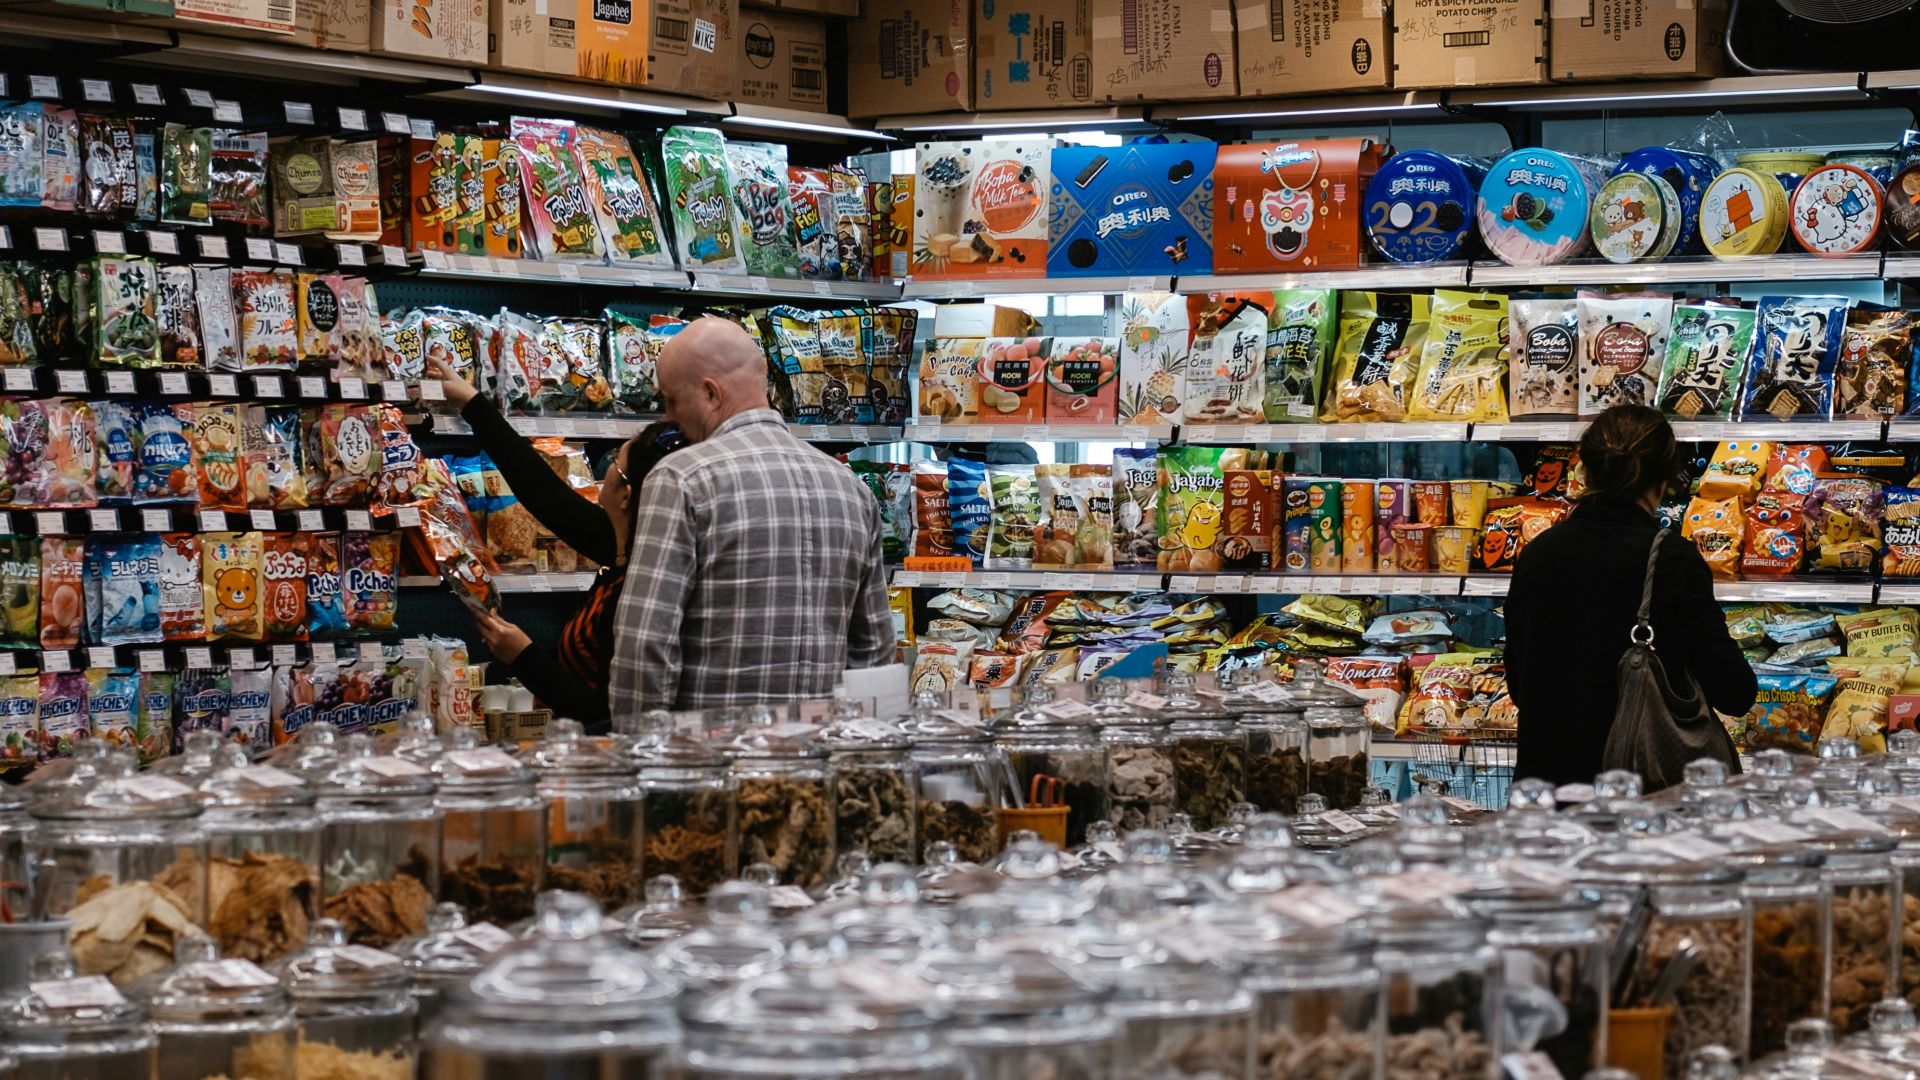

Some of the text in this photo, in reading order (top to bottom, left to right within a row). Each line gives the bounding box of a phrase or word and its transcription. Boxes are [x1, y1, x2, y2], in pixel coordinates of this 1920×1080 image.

[595, 0, 630, 19] Jagabee
[1436, 7, 1497, 17] POTATO CHIPS
[1173, 6, 1182, 38] FSML
[1323, 14, 1331, 41] KONG
[1603, 5, 1611, 35] CHIPS
[1613, 0, 1621, 41] AVOURED
[1622, 12, 1630, 31] bags
[1137, 20, 1145, 48] POTATO
[1294, 20, 1302, 48] CHIPS
[1303, 3, 1312, 58] FLAVOURED
[1312, 25, 1321, 46] bags
[694, 29, 715, 51] MIKE
[1161, 23, 1171, 58] KONG
[1275, 143, 1299, 152] OREO
[1406, 164, 1436, 173] OREO
[1527, 157, 1554, 169] OREO
[287, 167, 322, 180] Chimes
[337, 166, 369, 181] Chimes
[981, 170, 1017, 194] Boba
[983, 185, 1026, 208] Milk Tea
[1113, 191, 1148, 206] OREO
[1531, 332, 1567, 347] Boba
[1603, 331, 1643, 346] Boba
[929, 353, 977, 371] Pineapple
[949, 365, 977, 379] Cake
[1125, 468, 1157, 489] Jaga
[1170, 473, 1223, 494] Jagabe
[1056, 495, 1077, 510] Jaga
[1090, 497, 1113, 512] Jaga
[111, 558, 160, 576] ラムネグミ
[1743, 558, 1789, 567] Caramel Corn
[1871, 624, 1902, 638] BUTTER
[1336, 660, 1393, 680] Tomato
[89, 694, 134, 712] HI-CHEW
[183, 695, 231, 712] HI-CHEW
[1756, 690, 1797, 703] ato Crisps
[39, 696, 81, 719] HI-CHEW
[369, 697, 417, 724] I-CHEW
